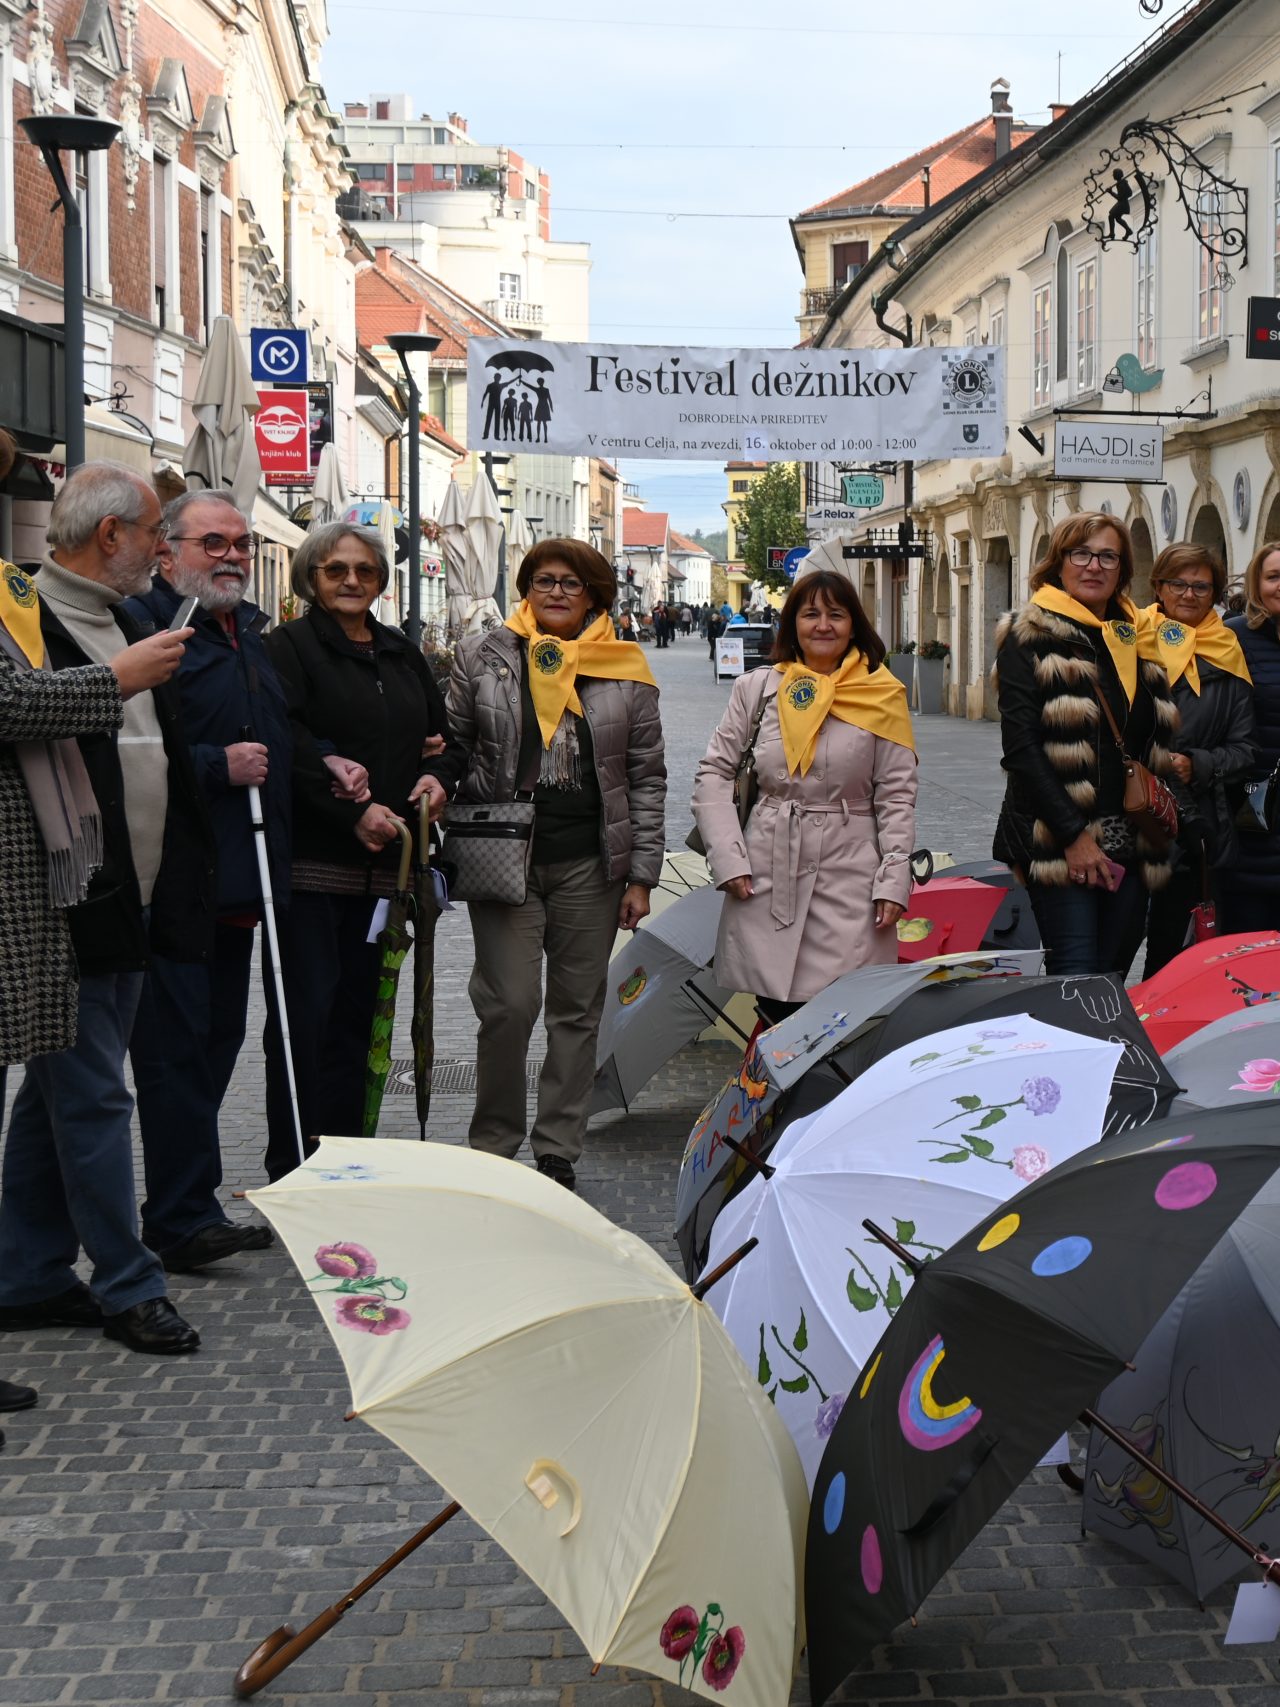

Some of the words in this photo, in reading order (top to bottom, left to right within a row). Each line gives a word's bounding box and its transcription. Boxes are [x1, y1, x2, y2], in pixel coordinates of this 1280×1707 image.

[955, 361, 981, 373] LIONS
[584, 355, 739, 397] Festival
[751, 359, 918, 397] dežnikov
[964, 373, 976, 389] L
[679, 413, 757, 425] DOBRODELNA
[761, 414, 828, 425] PRIREDITEV
[588, 434, 597, 446] V
[601, 437, 641, 448] centru
[644, 436, 679, 452] Celja,
[683, 439, 697, 449] na
[701, 438, 742, 451] zvezdi,
[746, 437, 765, 449] 16.
[770, 438, 817, 451] oktober
[820, 438, 836, 451] od
[841, 439, 873, 450] 10:00
[885, 438, 917, 449] 12:00
[1061, 435, 1157, 459] HAJDI.si
[260, 449, 284, 458] knjižni
[286, 450, 302, 458] klub
[849, 496, 880, 504] VARD
[824, 509, 855, 519] Relax
[544, 653, 555, 665] L
[800, 690, 809, 701] L
